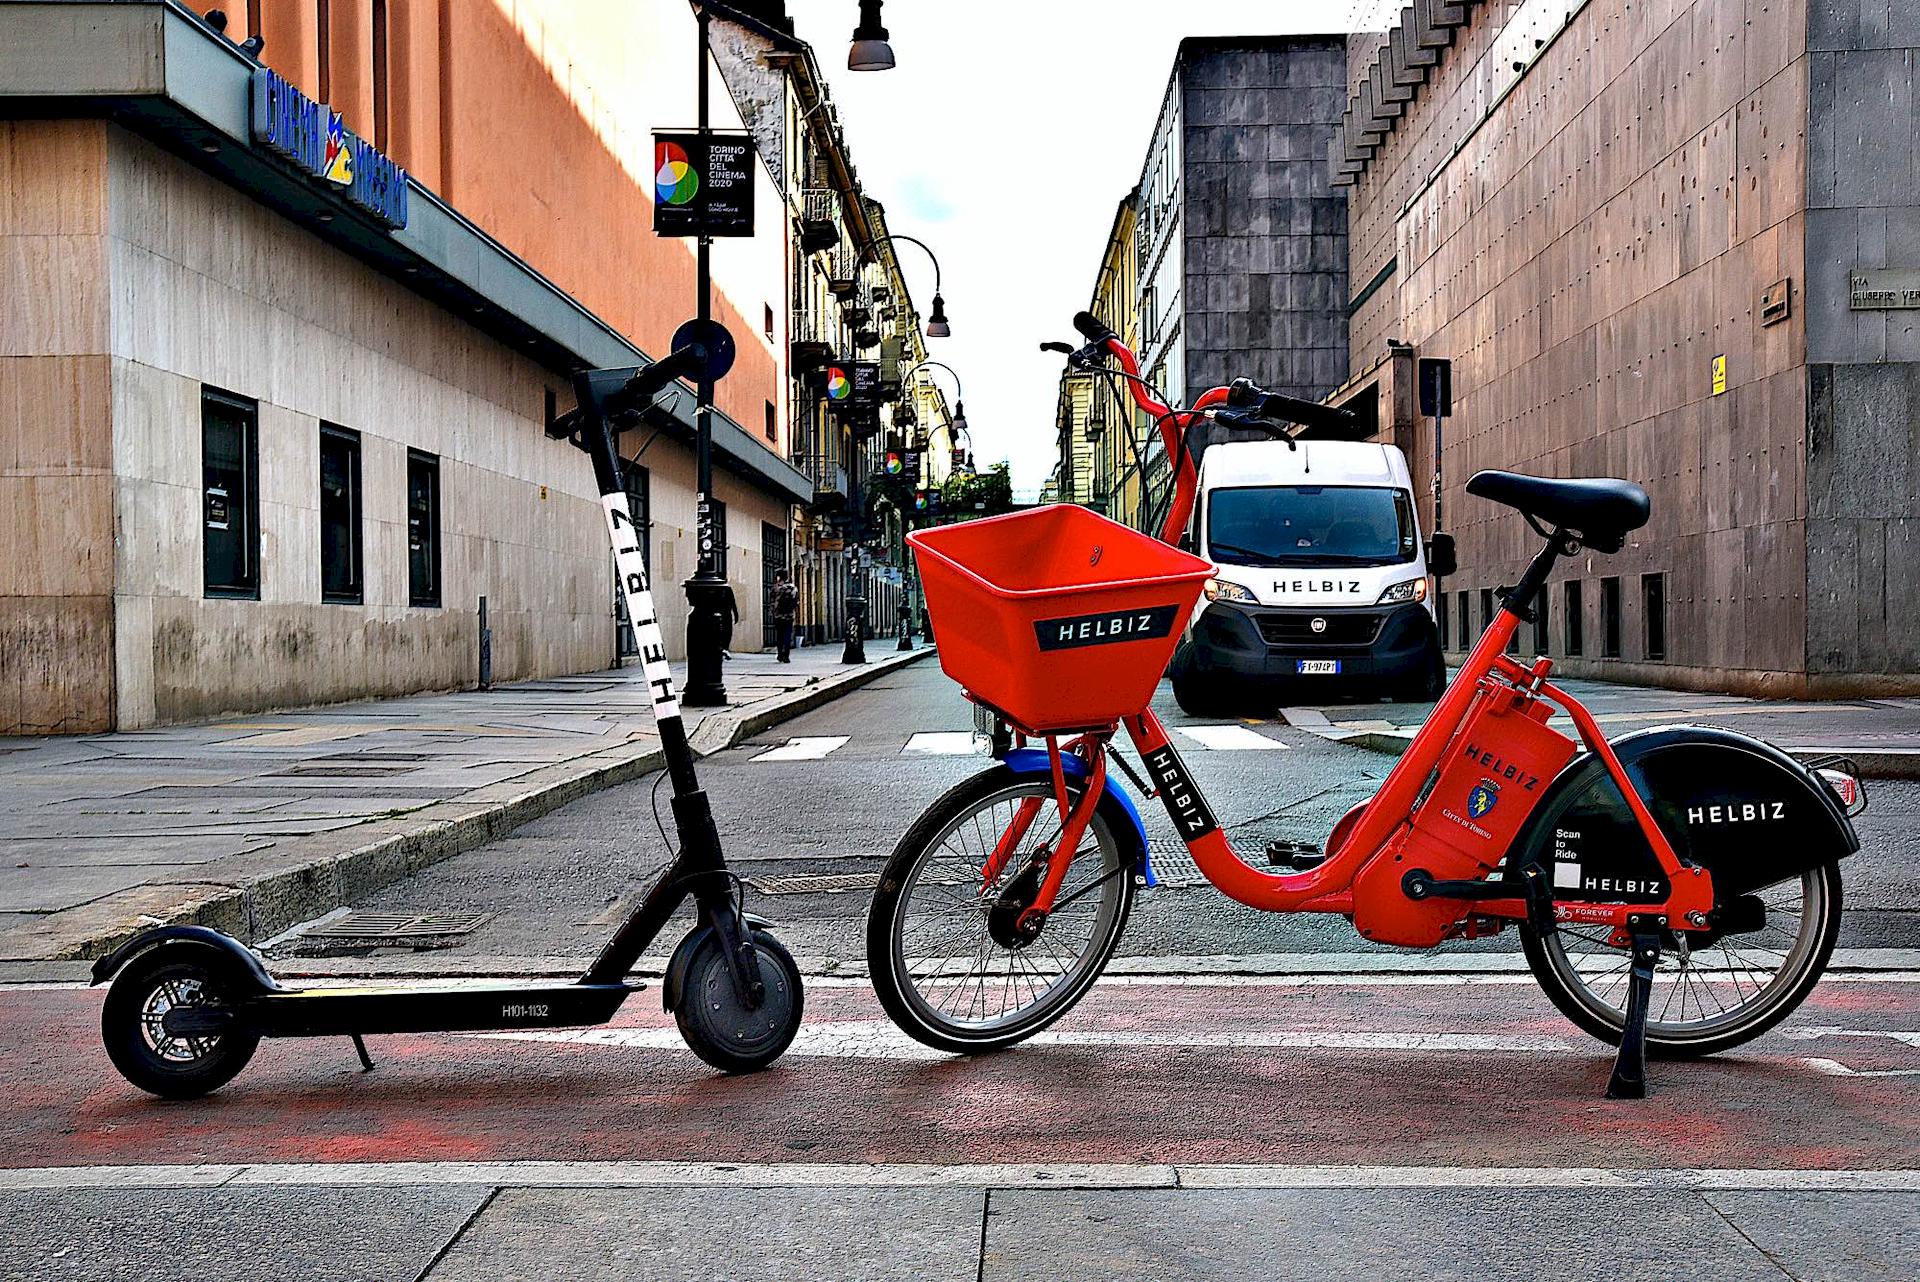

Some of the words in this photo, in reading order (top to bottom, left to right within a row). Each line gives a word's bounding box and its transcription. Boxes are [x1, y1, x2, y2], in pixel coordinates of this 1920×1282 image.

[266, 67, 320, 173] CINEMA
[708, 145, 746, 154] TORINO
[709, 163, 727, 171] DEL
[708, 171, 746, 180] CINEMA
[708, 179, 733, 188] 2020
[1851, 276, 1868, 287] VIA
[1852, 290, 1896, 301] GIUSEPPE
[1273, 580, 1360, 593] HELBIZ
[610, 508, 677, 704] HELBIZ
[1058, 614, 1152, 641] HELBIZ
[1463, 743, 1540, 791] HELBIZ
[1153, 752, 1205, 832] HELBIZ
[1688, 802, 1785, 825] HELBIZ
[1556, 828, 1581, 839] Scan
[1555, 840, 1566, 848] to
[1555, 849, 1577, 859] Ride
[1585, 877, 1660, 894] HELBIZ
[1575, 908, 1614, 917] FOREVER
[502, 1004, 549, 1017] H101-1132
